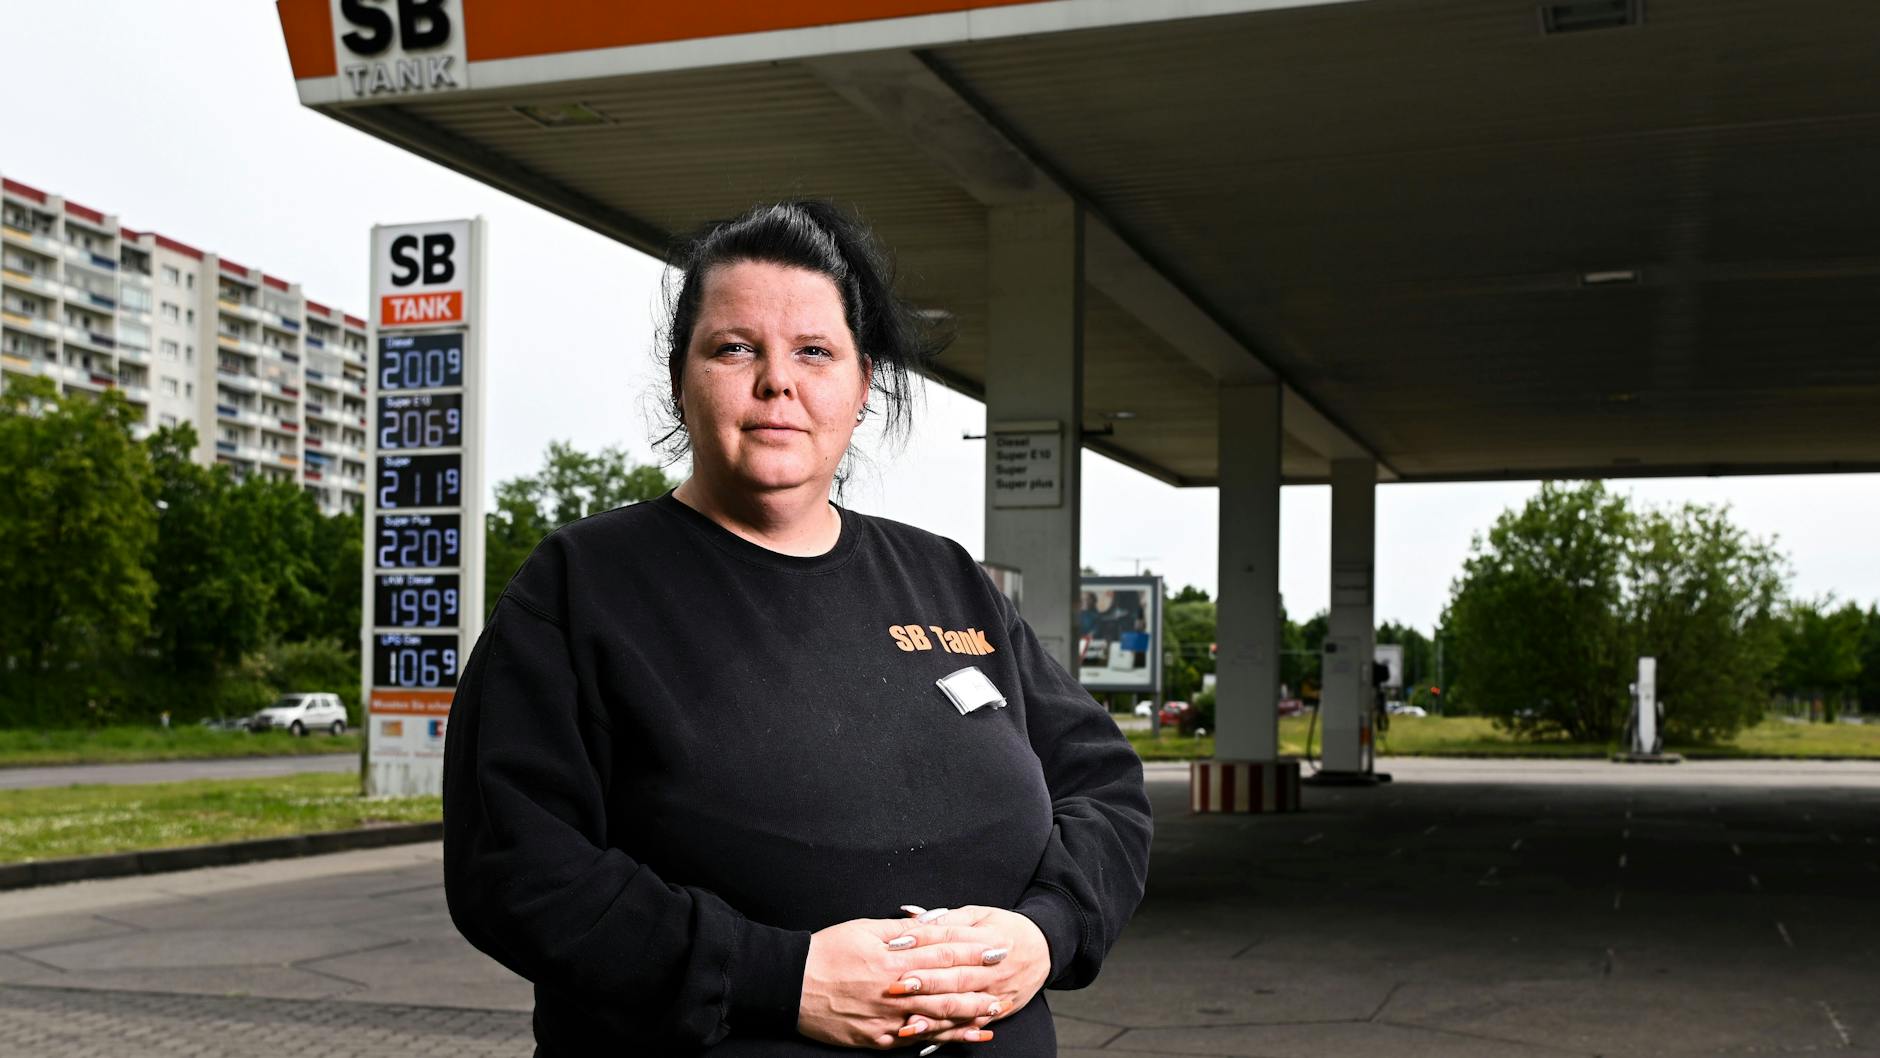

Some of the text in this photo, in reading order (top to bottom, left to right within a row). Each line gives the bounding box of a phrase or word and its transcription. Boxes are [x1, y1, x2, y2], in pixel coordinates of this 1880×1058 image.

[340, 0, 452, 56] SB
[346, 56, 457, 96] TANK
[390, 233, 456, 287] SB
[390, 296, 452, 321] TANK
[997, 438, 1030, 447] Diesel
[996, 451, 1027, 461] Super
[996, 465, 1027, 475] Super
[996, 479, 1027, 489] Super
[888, 624, 996, 656] SB Tank
